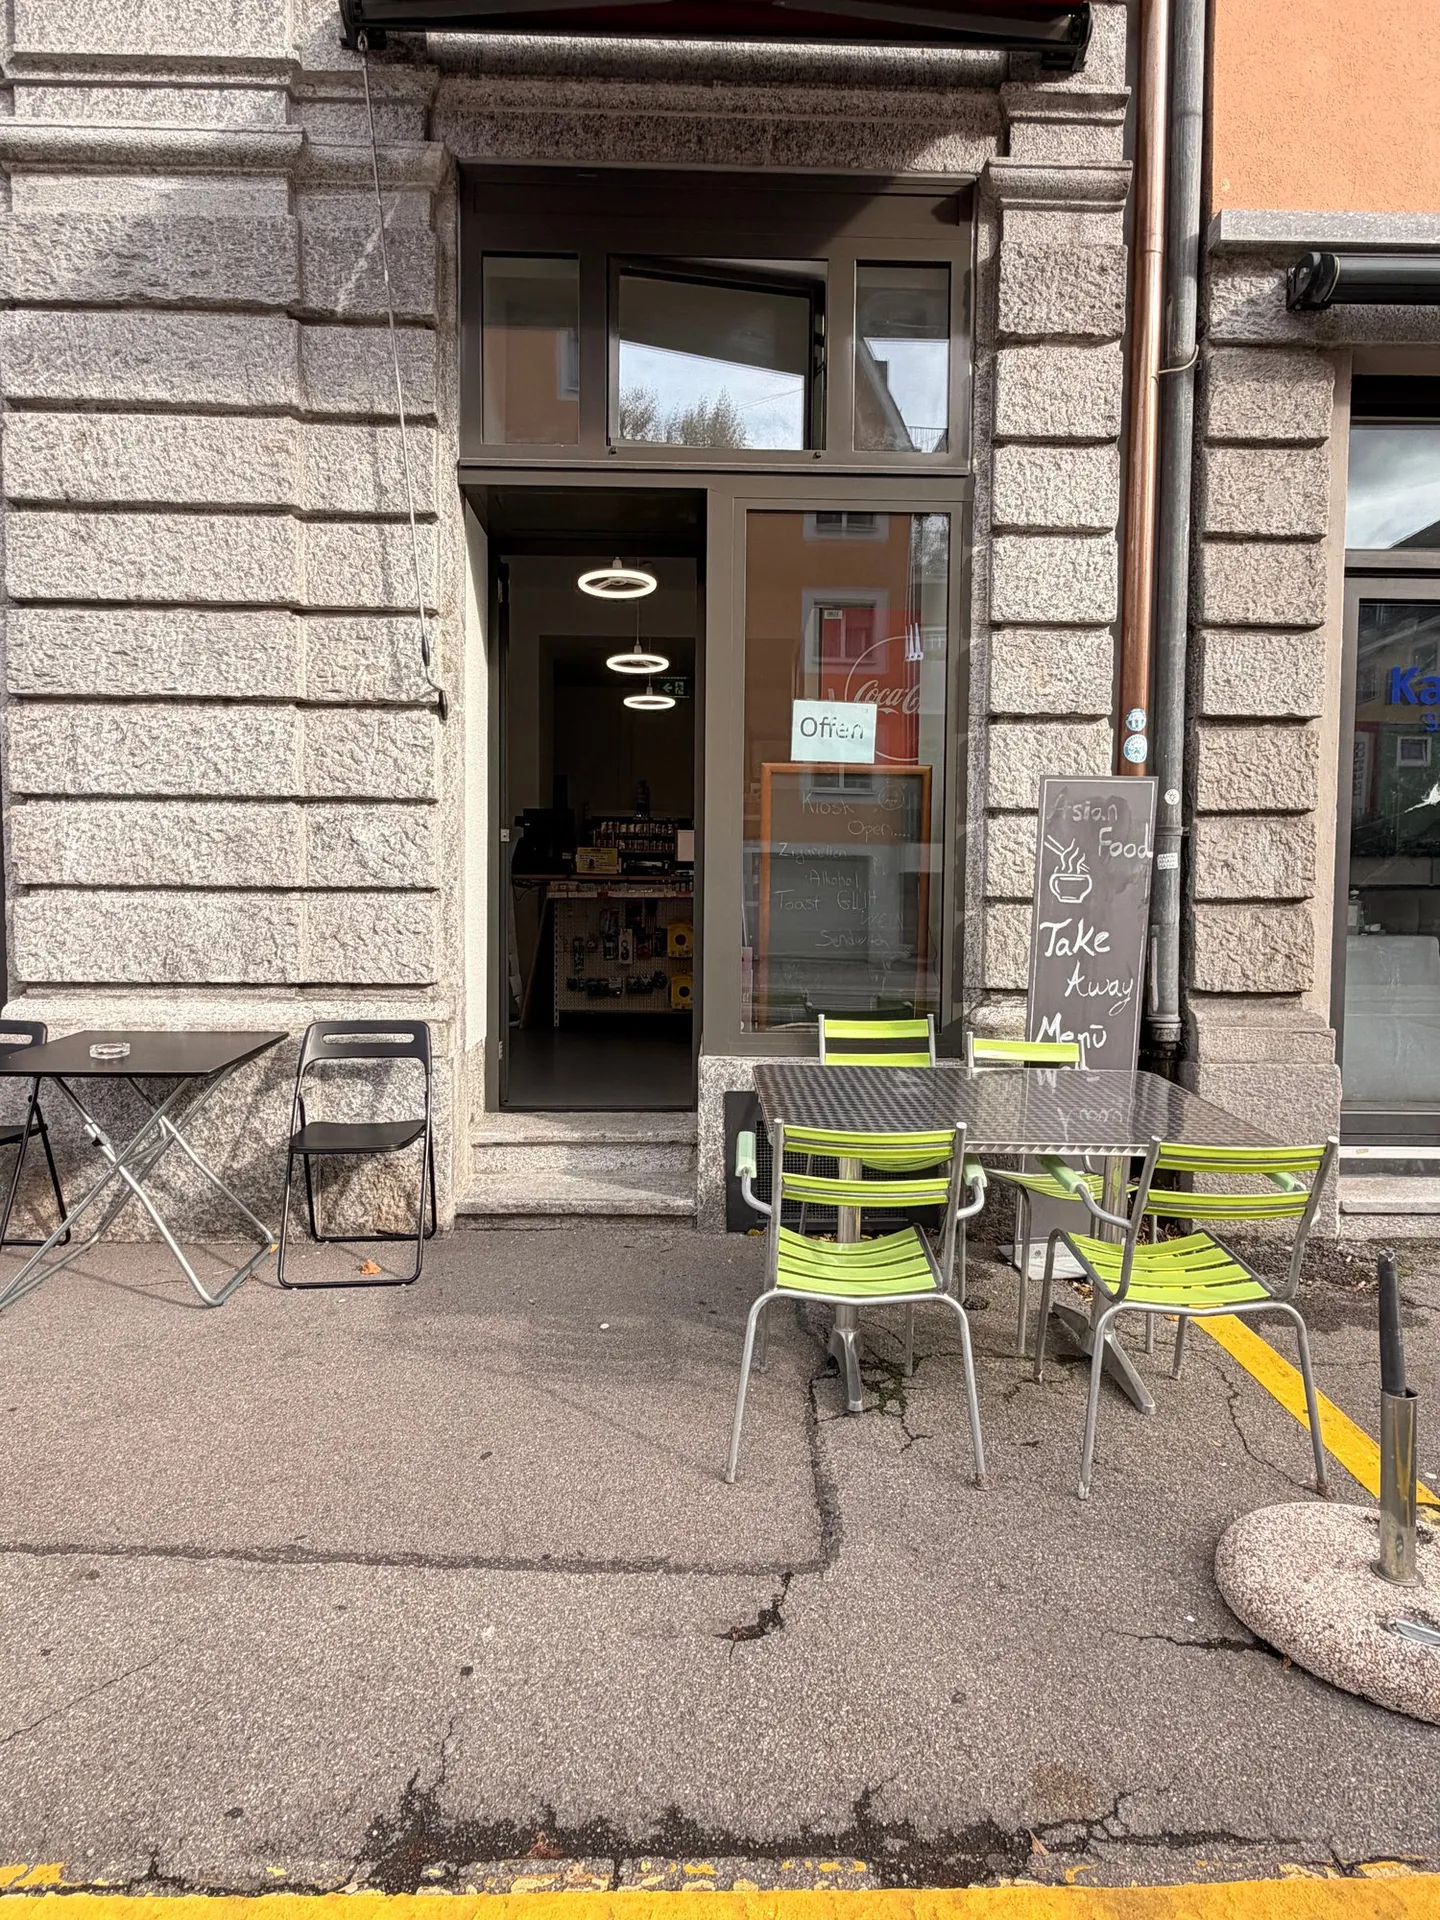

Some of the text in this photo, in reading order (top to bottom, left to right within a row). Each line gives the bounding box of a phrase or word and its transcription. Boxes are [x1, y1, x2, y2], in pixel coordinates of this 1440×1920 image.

[800, 716, 864, 739] Offen
[802, 791, 855, 815] Kiosk
[1098, 822, 1153, 859] Food
[773, 889, 821, 911] Toast
[1039, 917, 1111, 958] Take
[1064, 960, 1134, 1017] Away
